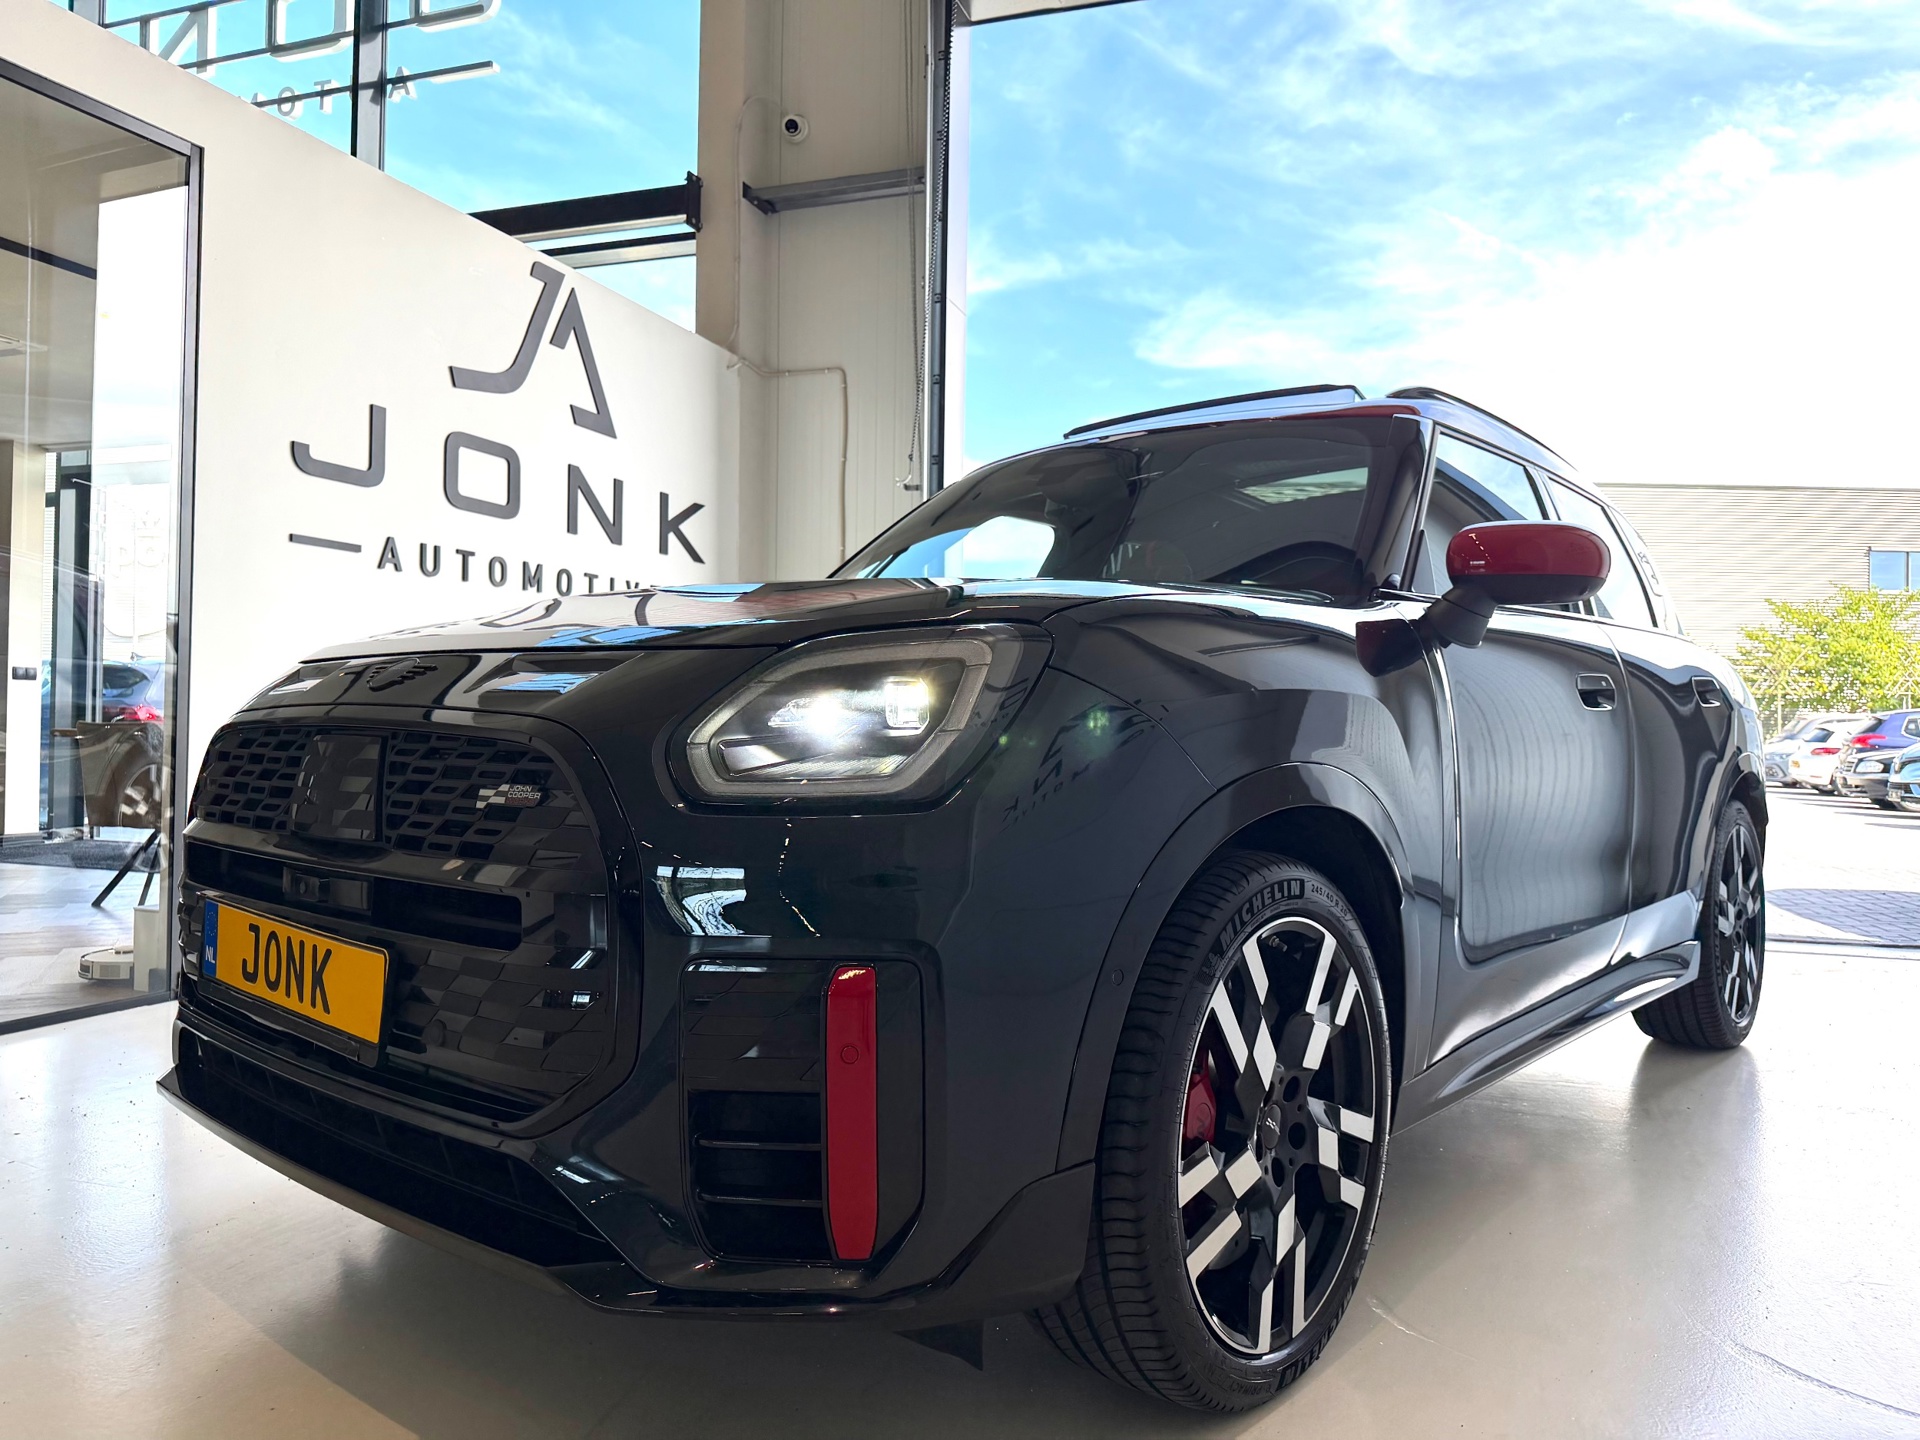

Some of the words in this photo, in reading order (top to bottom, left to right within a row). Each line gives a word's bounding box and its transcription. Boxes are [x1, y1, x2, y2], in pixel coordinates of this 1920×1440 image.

[291, 404, 706, 565] JONK
[377, 536, 661, 597] AUTOMOTI
[1219, 879, 1300, 952] MICHELIN
[1311, 884, 1334, 903] 245/40
[205, 945, 216, 964] NL
[242, 922, 333, 1015] JONK
